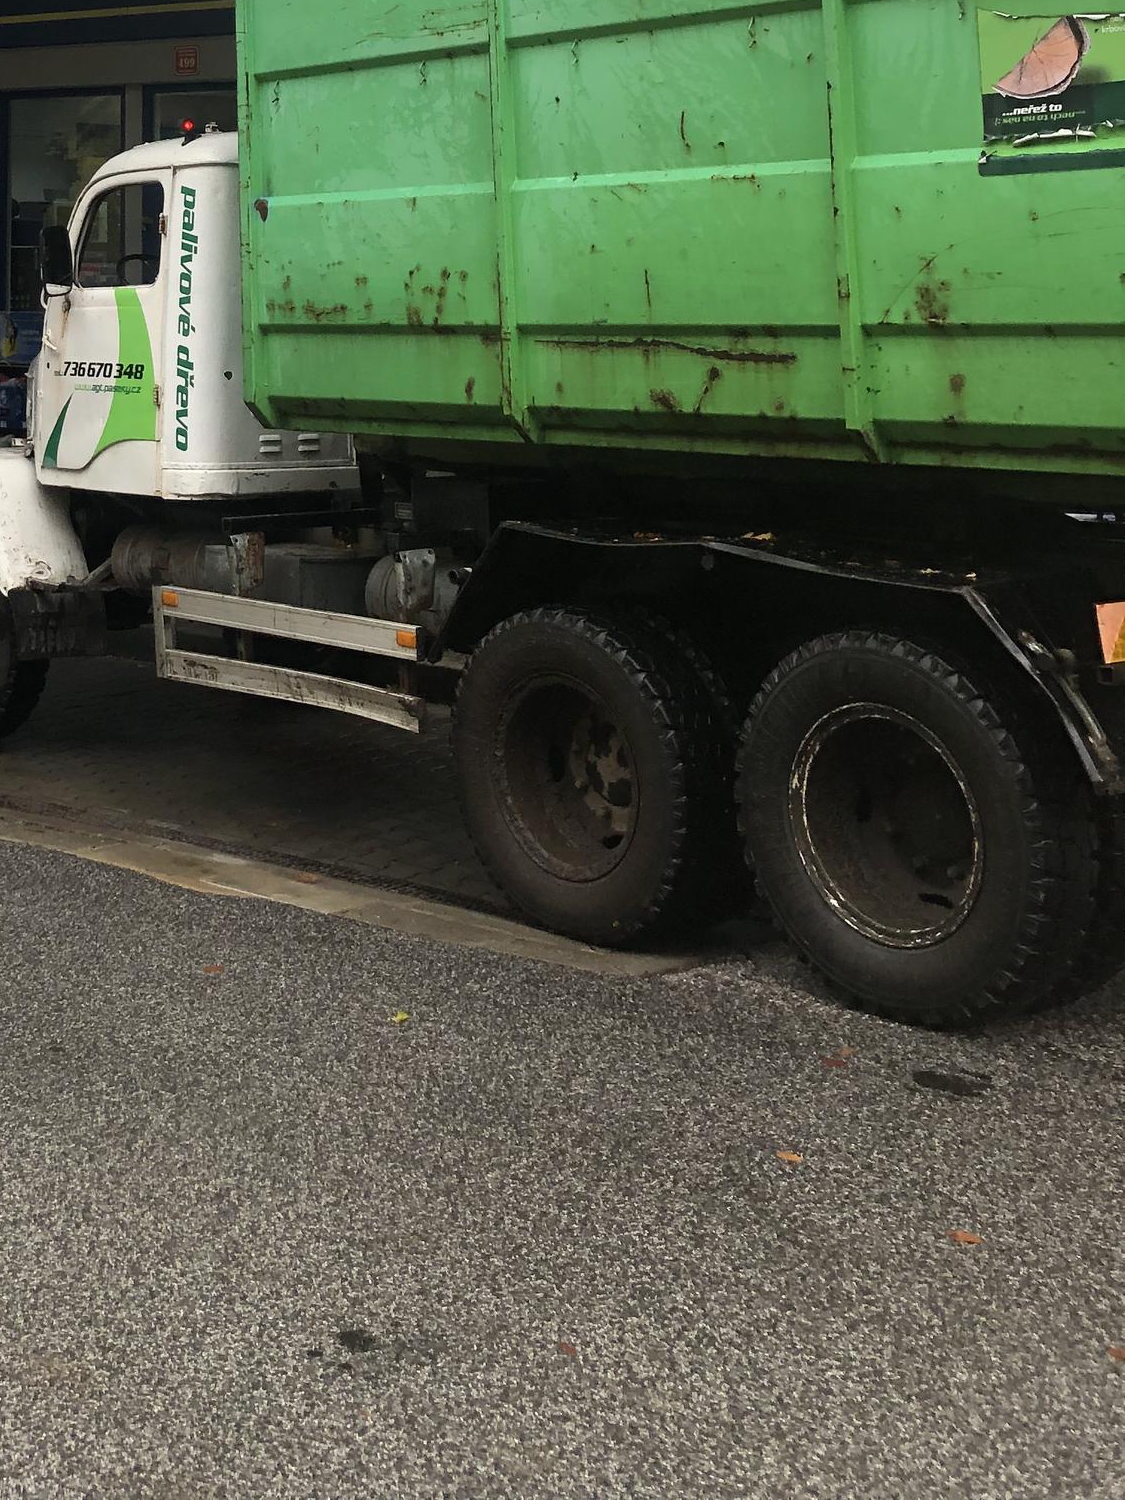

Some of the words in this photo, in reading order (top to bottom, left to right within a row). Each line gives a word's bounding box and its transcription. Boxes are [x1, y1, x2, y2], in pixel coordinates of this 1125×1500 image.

[1048, 103, 1063, 112] to
[177, 186, 198, 338] palivové
[63, 361, 87, 377] 736
[87, 362, 113, 378] 670
[113, 363, 145, 380] 348
[175, 344, 195, 452] dřevo
